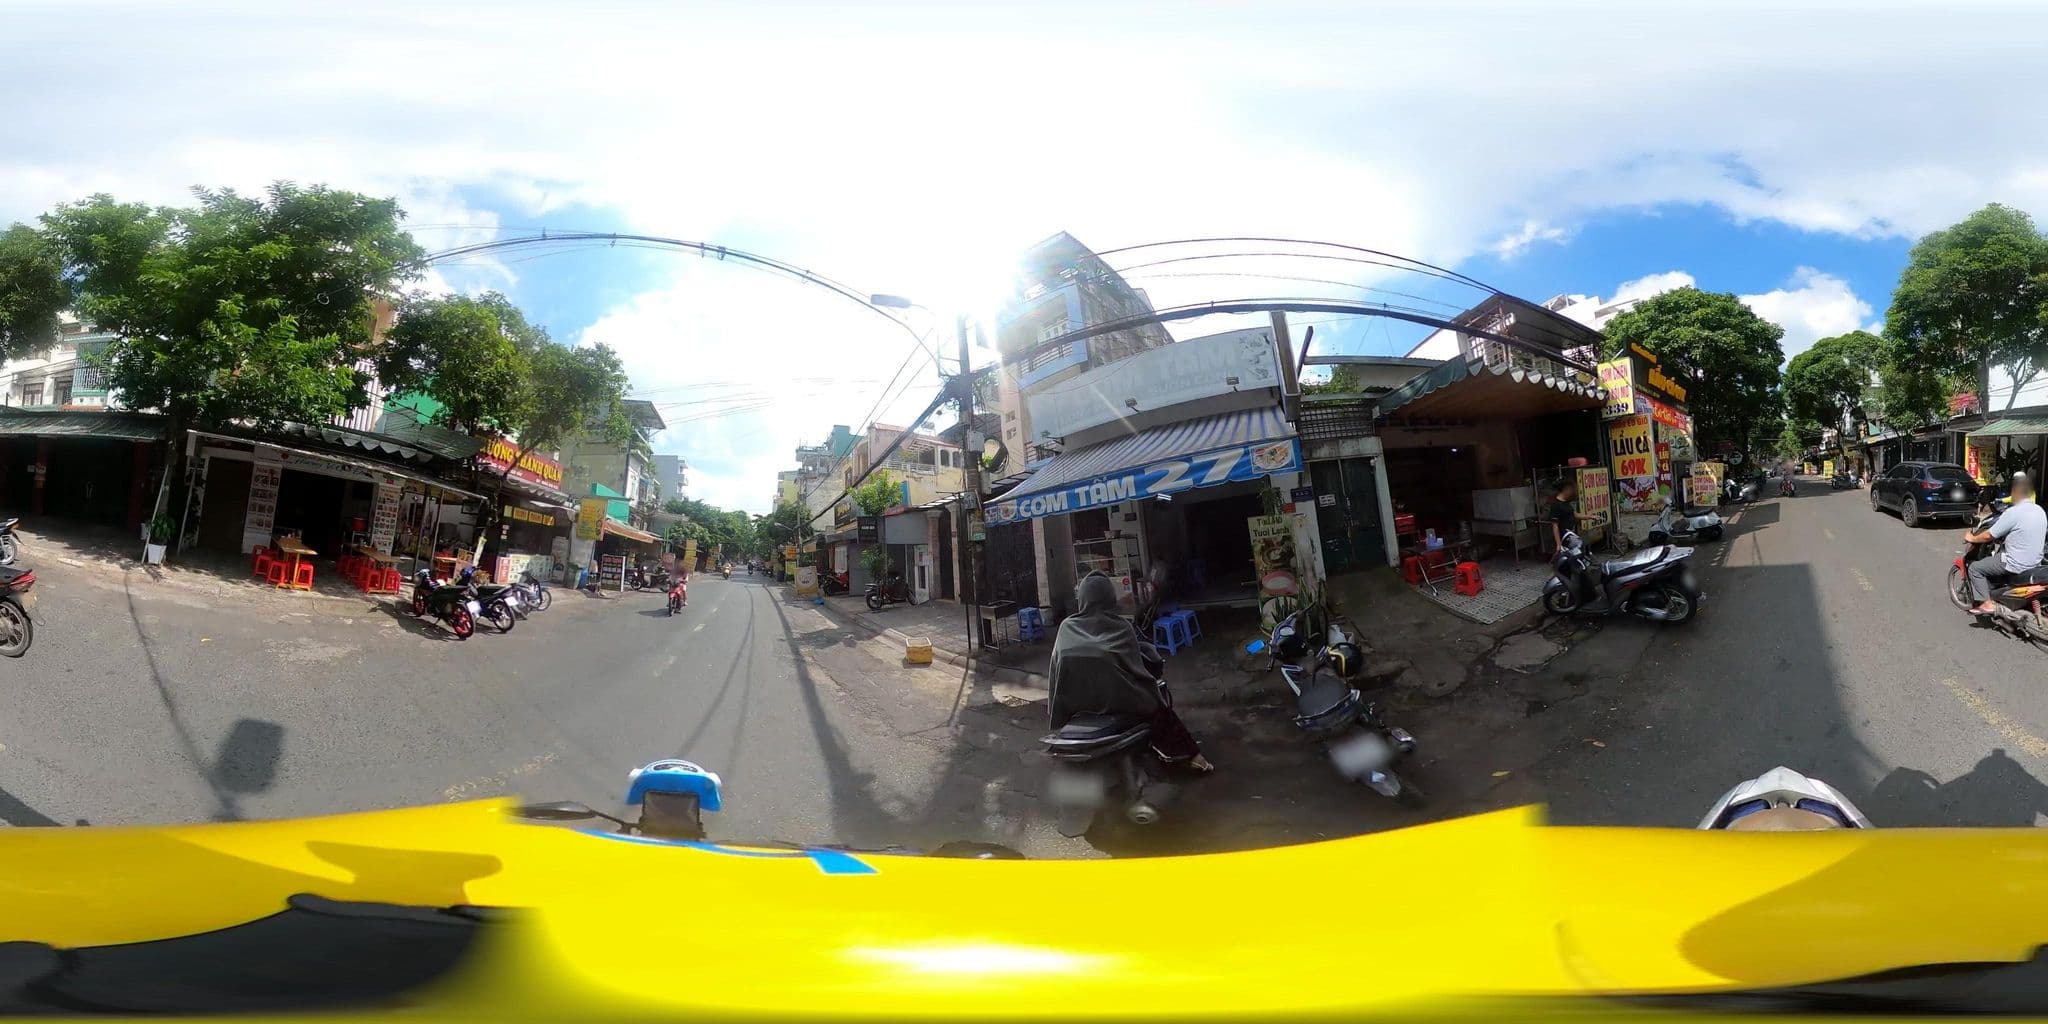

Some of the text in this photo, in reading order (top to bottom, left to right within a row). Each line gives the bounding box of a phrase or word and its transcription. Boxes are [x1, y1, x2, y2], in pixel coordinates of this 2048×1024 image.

[1606, 402, 1628, 415] 339
[1636, 429, 1650, 453] CÁ
[1144, 447, 1245, 494] 27
